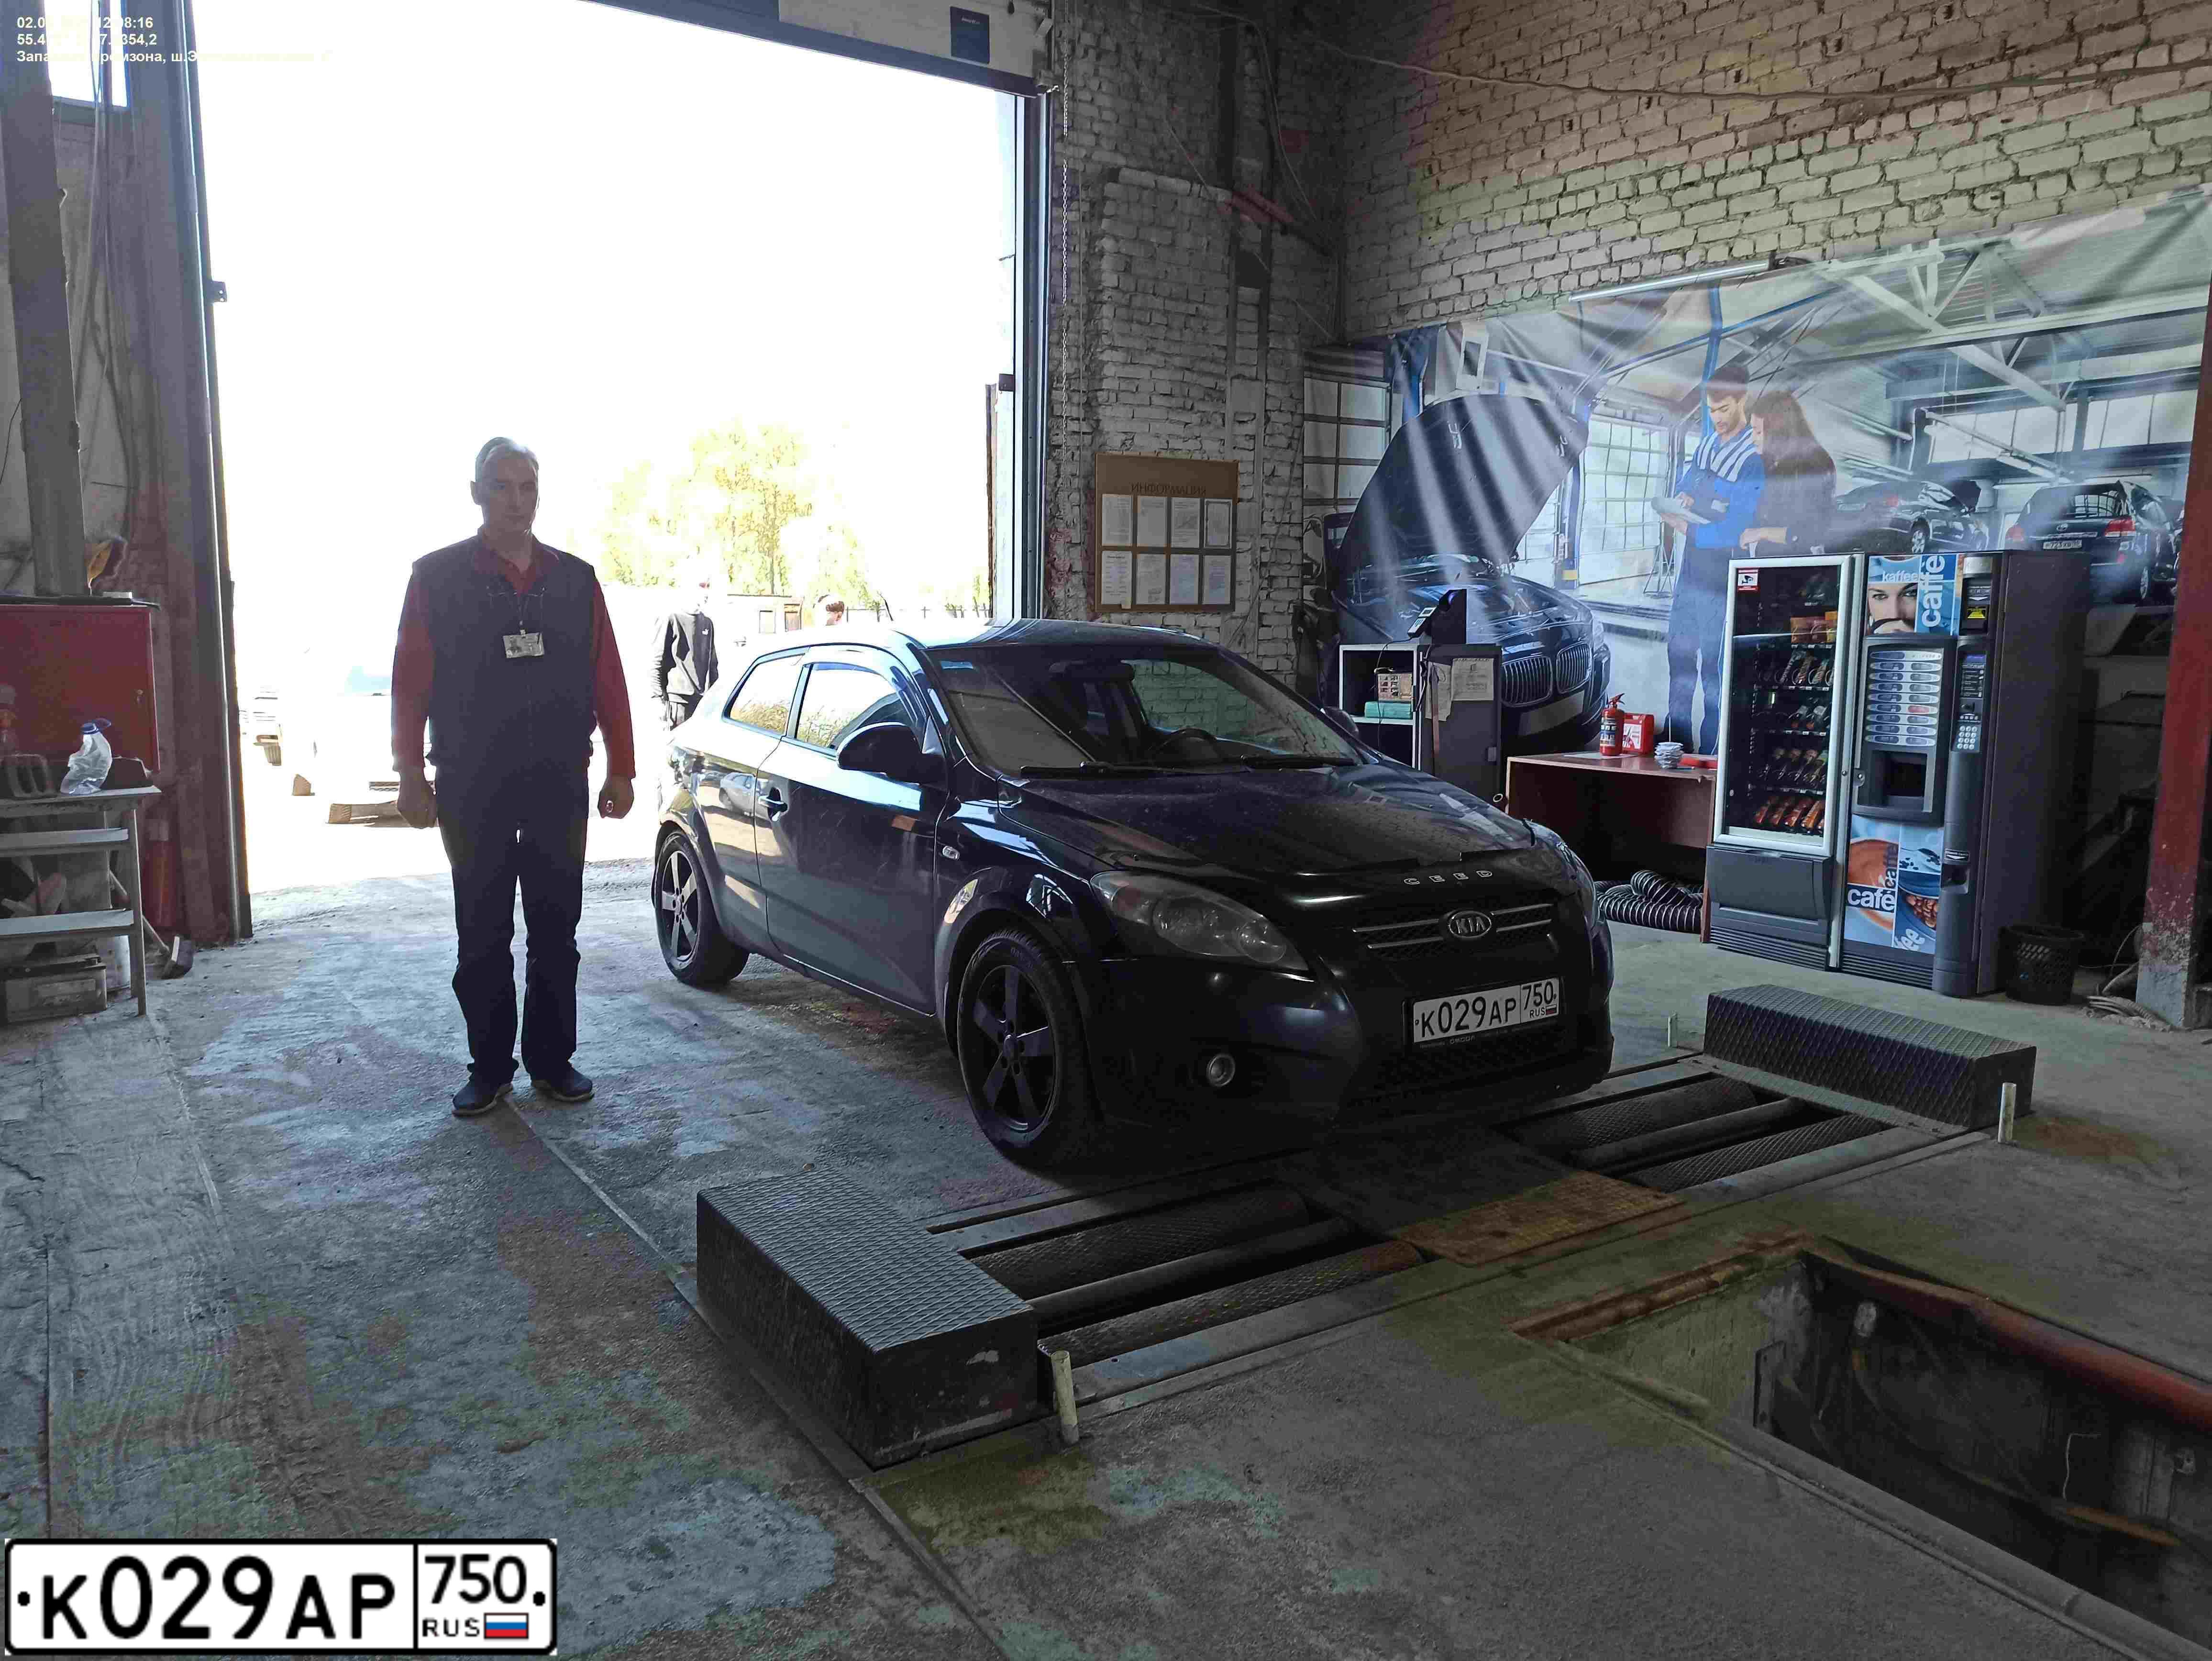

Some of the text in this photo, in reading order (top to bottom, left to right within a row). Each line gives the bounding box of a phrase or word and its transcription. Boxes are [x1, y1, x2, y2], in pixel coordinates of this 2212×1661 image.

[1131, 483, 1206, 495] ИНФОРМАЦИЯ
[1455, 916, 1486, 934] KIA
[1421, 981, 1554, 1038] К029АР 750
[1529, 1007, 1546, 1018] RUS
